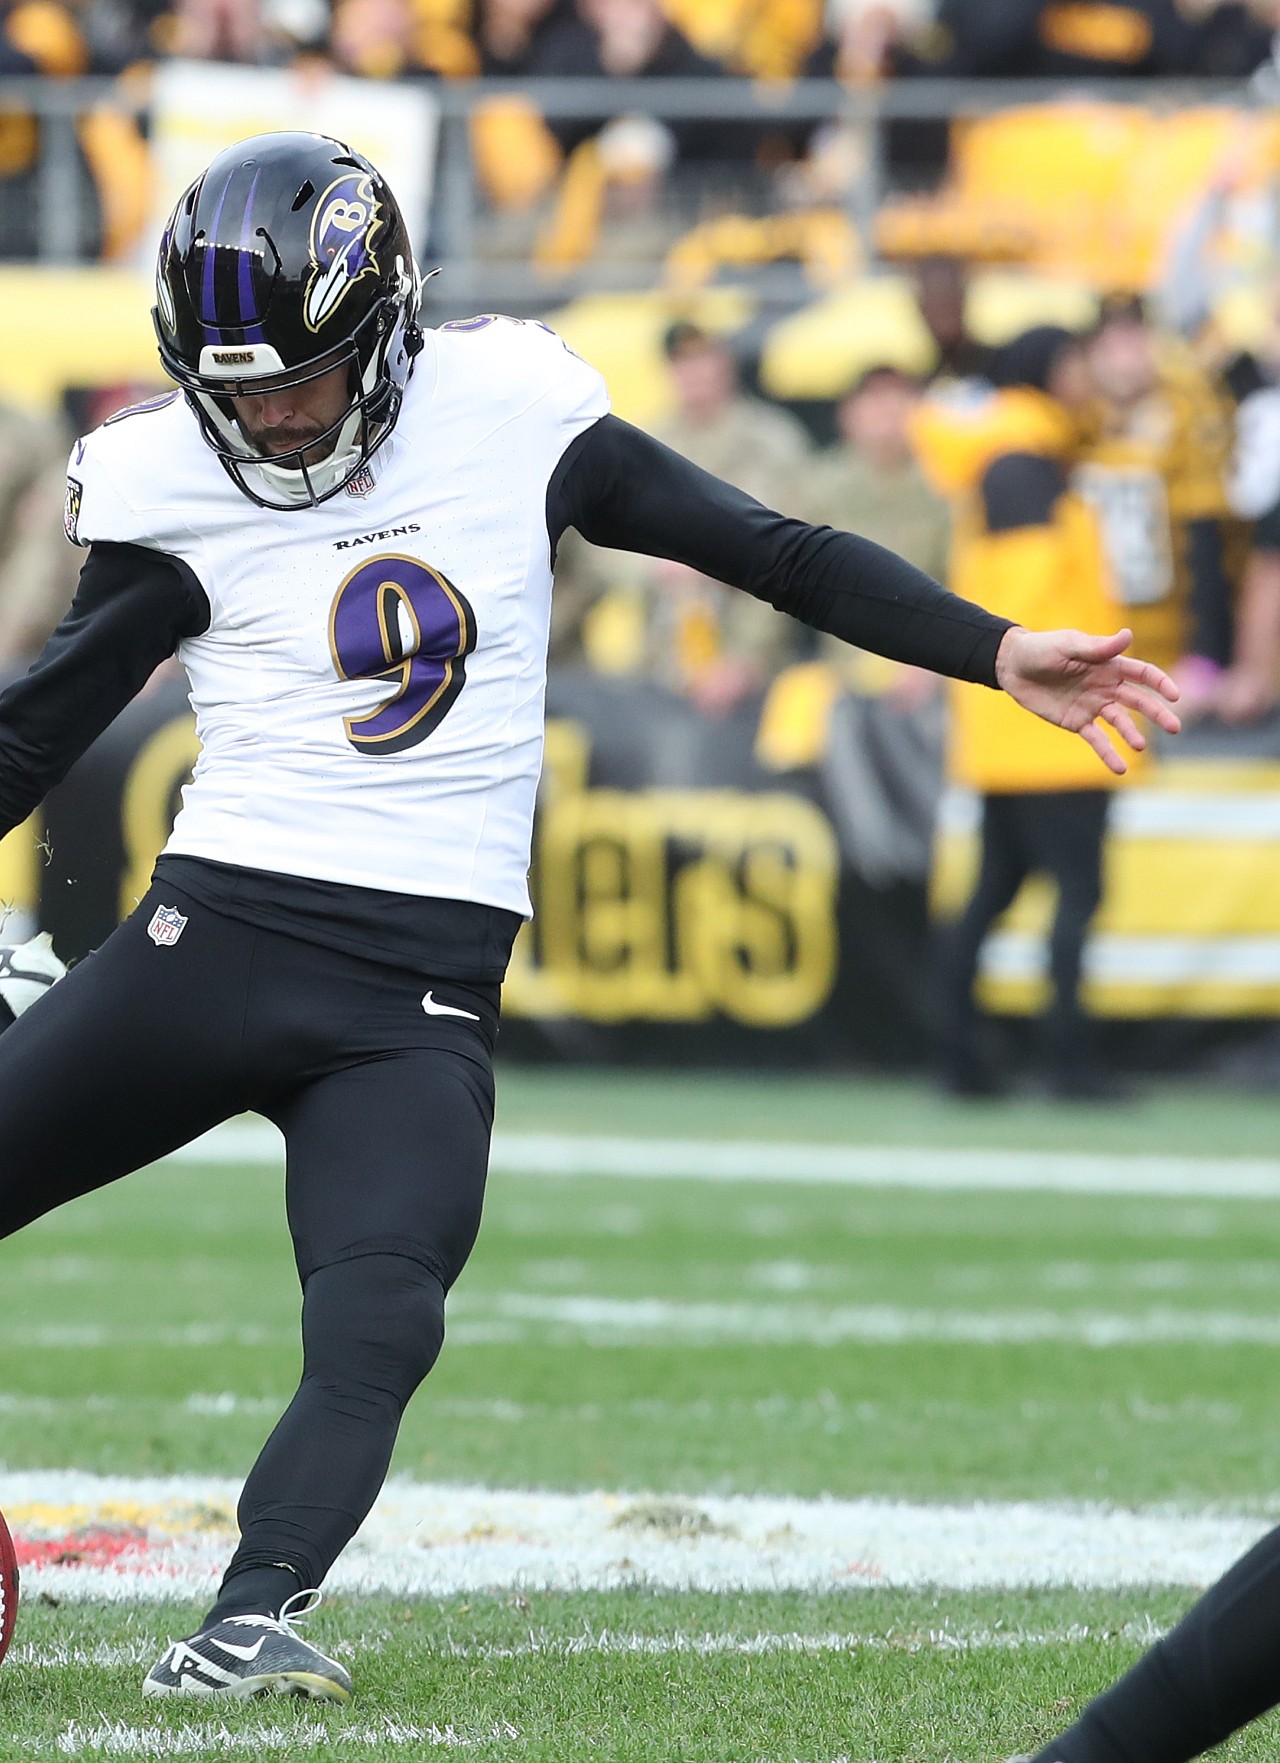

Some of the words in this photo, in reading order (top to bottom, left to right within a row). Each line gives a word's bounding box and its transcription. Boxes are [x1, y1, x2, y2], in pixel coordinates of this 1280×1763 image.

[211, 351, 255, 365] RAVENS
[348, 477, 372, 493] NFL
[332, 523, 421, 550] RAVENS
[328, 552, 477, 755] 9
[153, 920, 175, 940] NFL
